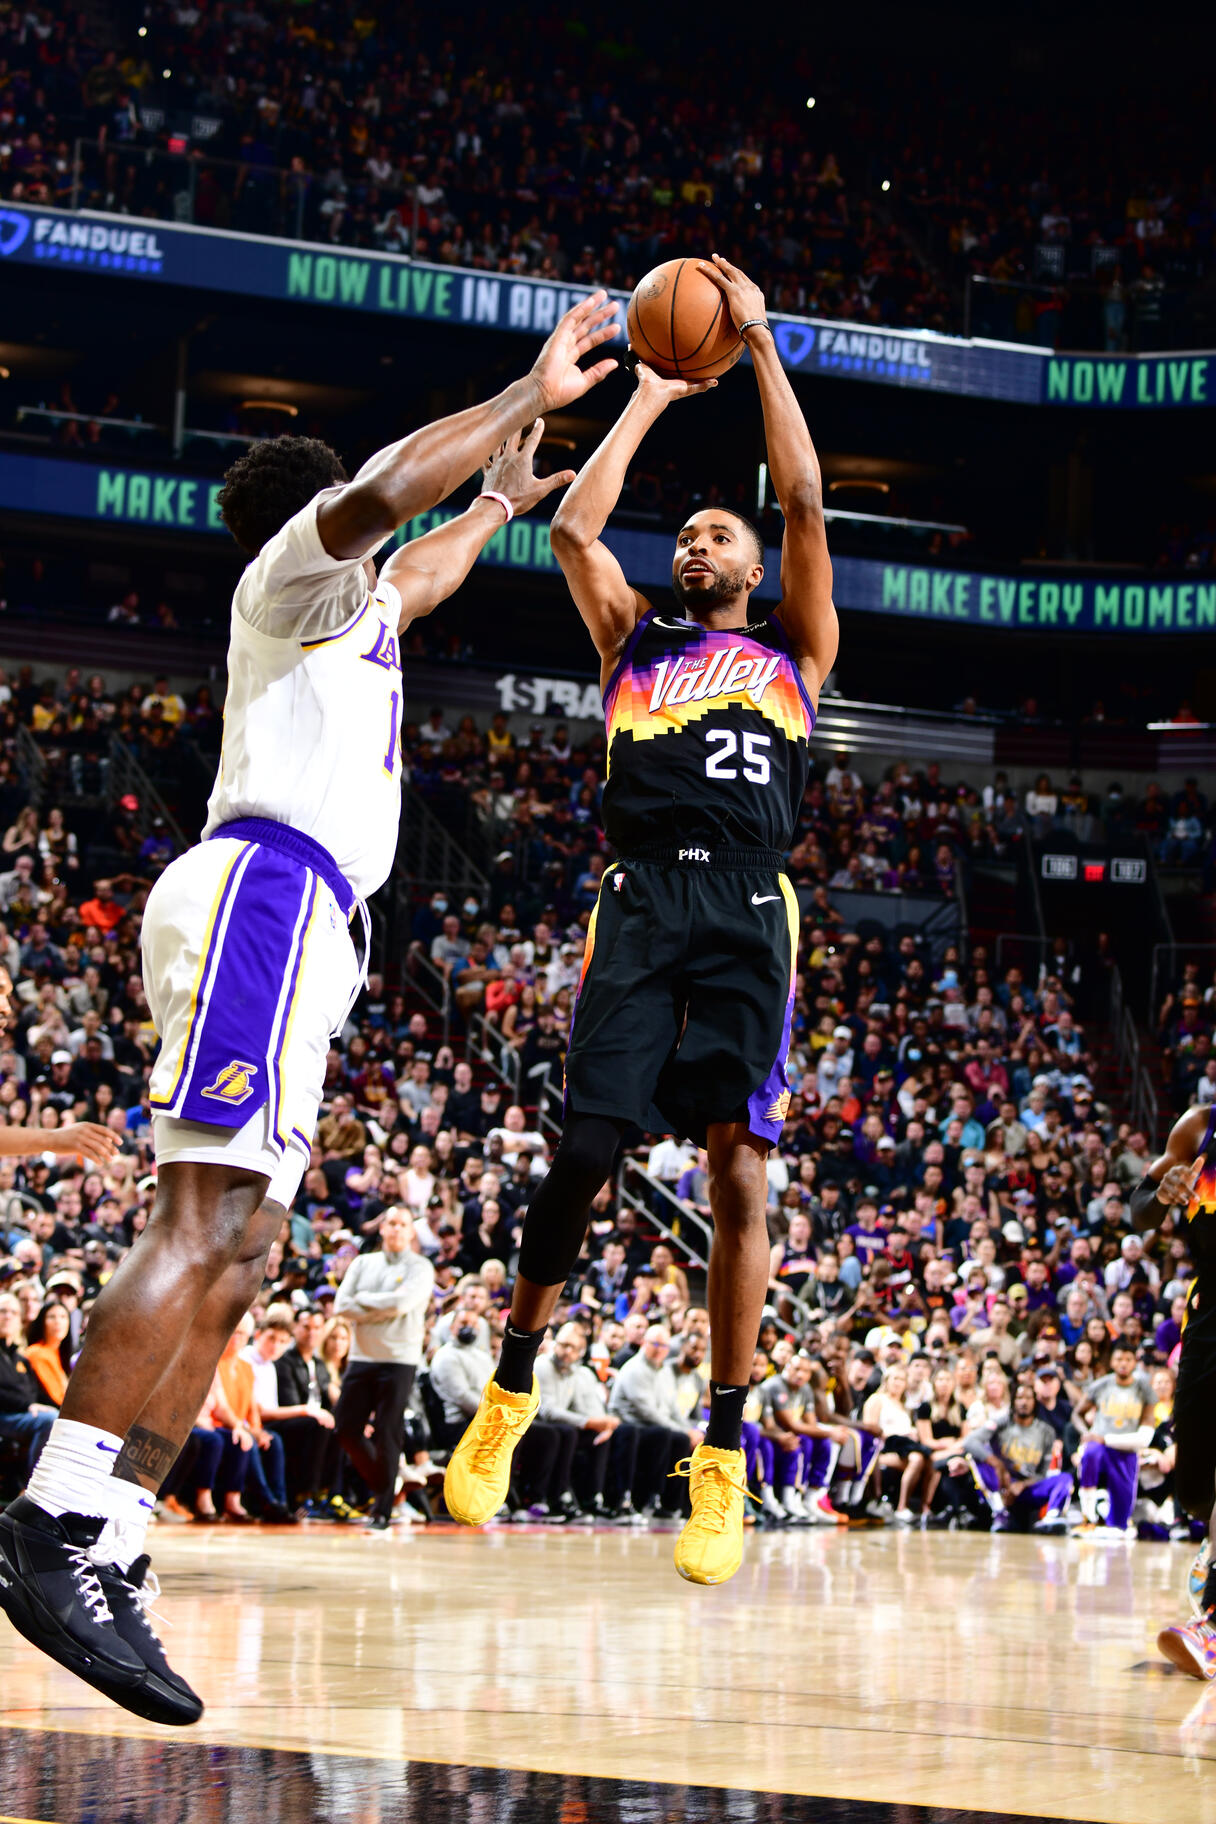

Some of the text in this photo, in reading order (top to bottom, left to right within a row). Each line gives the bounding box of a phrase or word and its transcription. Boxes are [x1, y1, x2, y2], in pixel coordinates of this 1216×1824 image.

[34, 218, 163, 259] FANDUEL
[288, 252, 369, 305] NOW
[378, 265, 453, 317] LIVE
[461, 276, 500, 323] IN
[819, 329, 931, 368] FANDUEL
[1048, 359, 1208, 403] NOW LIVE
[97, 470, 197, 525] MAKE
[481, 521, 562, 570] MOR
[883, 566, 1216, 628] MAKE EVERY MOMEN
[360, 617, 402, 671] LA
[684, 658, 708, 672] THE
[495, 673, 605, 721] 1STBA
[649, 645, 781, 714] Valley
[381, 688, 402, 781] 1
[705, 728, 771, 785] 25
[678, 848, 710, 863] PHX
